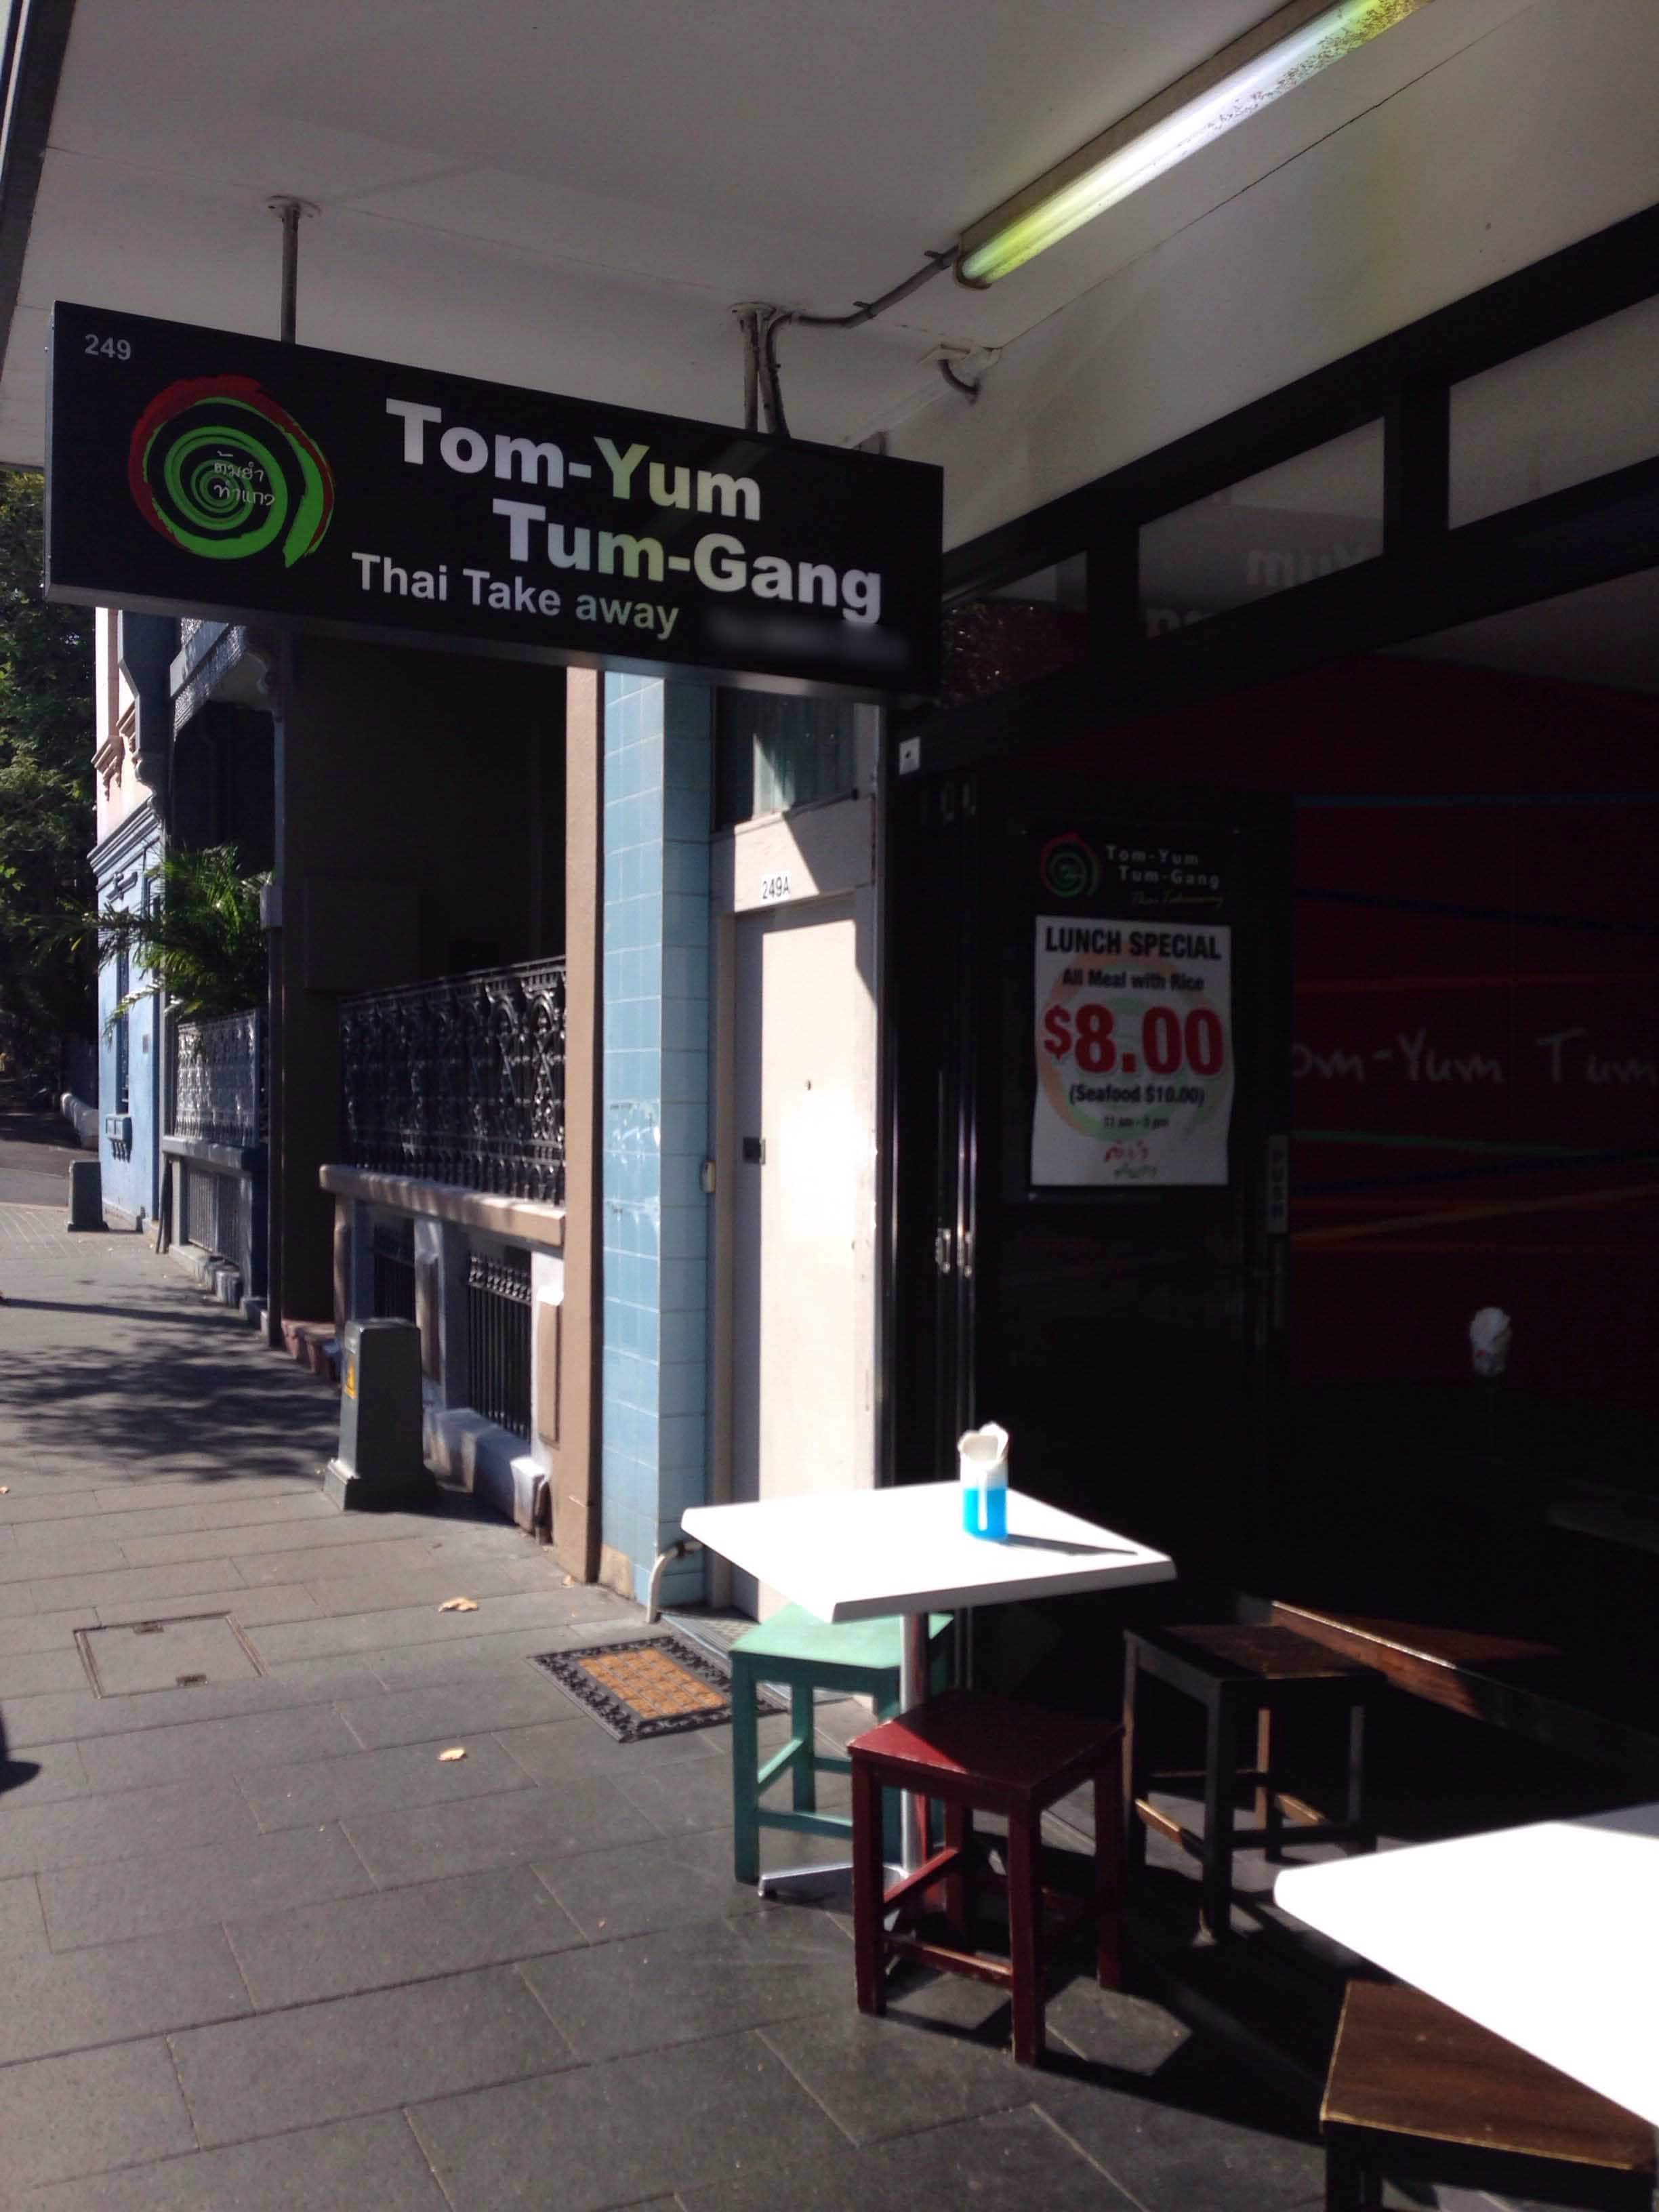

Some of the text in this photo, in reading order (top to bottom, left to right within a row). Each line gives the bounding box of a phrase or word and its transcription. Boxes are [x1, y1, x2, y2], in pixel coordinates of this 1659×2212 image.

[85, 334, 131, 361] 249
[386, 398, 760, 520] Tom-Yum
[493, 498, 882, 624] Tum-Gang
[352, 552, 447, 600] Thai
[463, 568, 562, 616] Take
[575, 594, 679, 638] away
[1105, 842, 1199, 866] Tom-Yum
[762, 876, 790, 899] 249A
[1118, 864, 1220, 891] Tum-Gang
[1046, 926, 1222, 959] LUNCH SPECIAL
[1063, 968, 1204, 991] All Meal with Rice
[1044, 1004, 1223, 1076] $8.00
[1070, 1084, 1141, 1105] (Seafood
